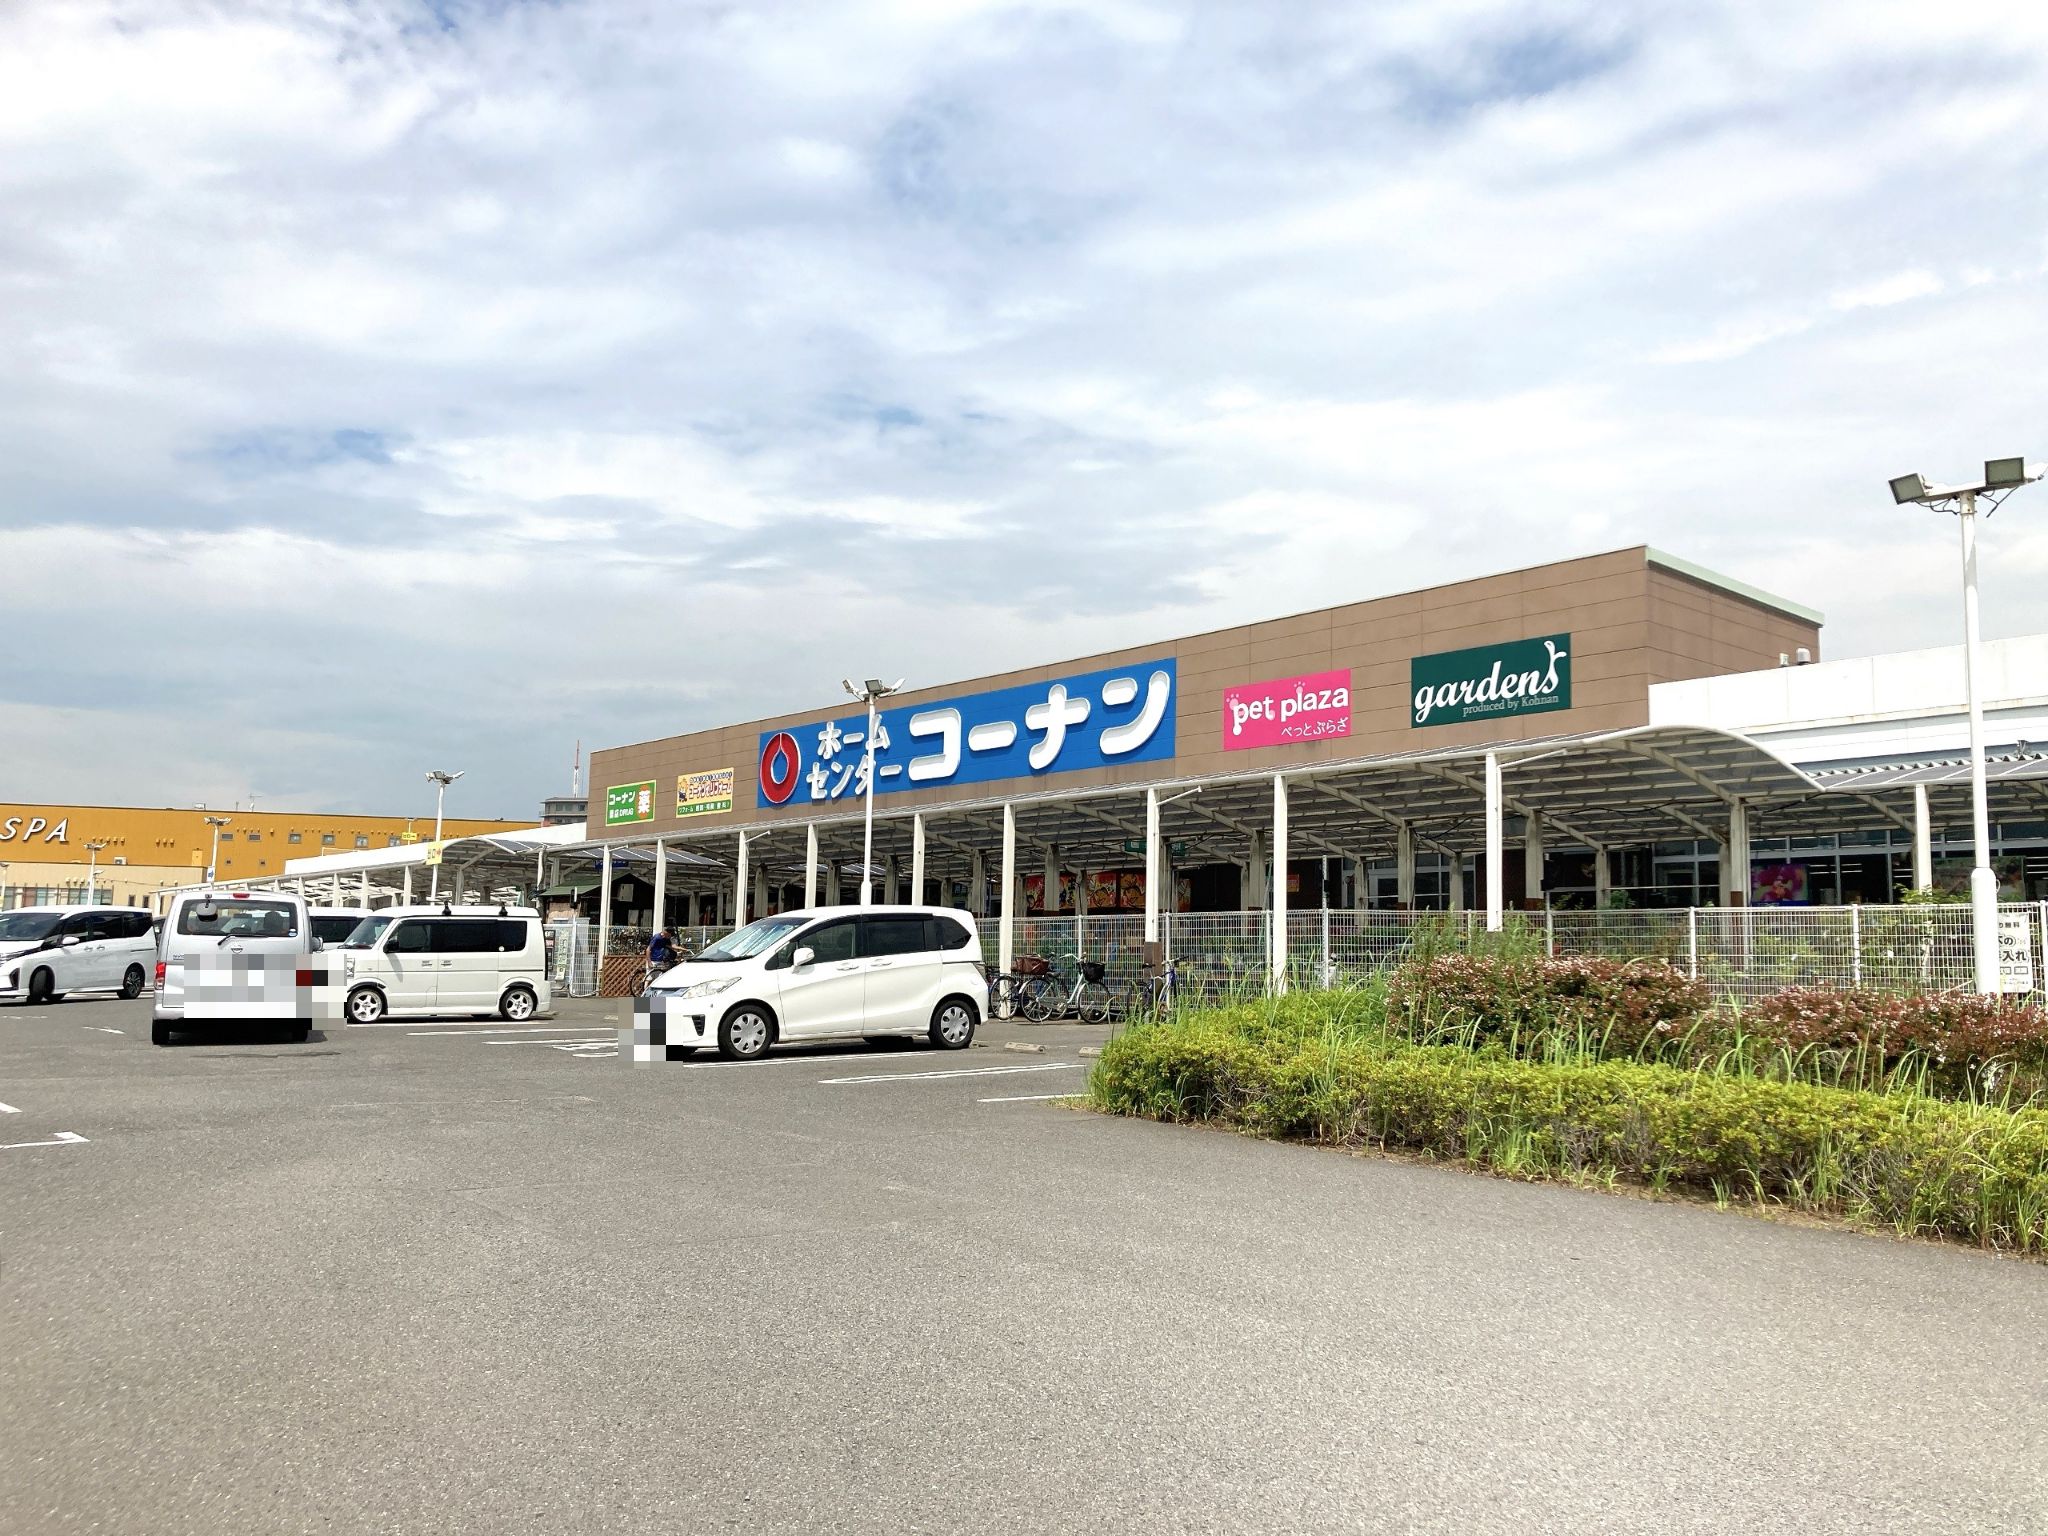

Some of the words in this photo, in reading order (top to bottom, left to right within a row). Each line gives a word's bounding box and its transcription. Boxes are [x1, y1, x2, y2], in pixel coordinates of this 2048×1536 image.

[1414, 640, 1567, 723] gardens
[1228, 696, 1276, 736] pet
[1281, 685, 1349, 723] plaza
[1462, 699, 1505, 717] produced
[1508, 699, 1519, 711] by
[1521, 695, 1559, 708] Kohnan
[818, 713, 891, 760] ホーム
[908, 670, 1170, 781] コーナン
[1281, 717, 1349, 737] ぺっとぷらざ
[608, 791, 636, 806] コーナン
[0, 817, 69, 843] SPA
[1999, 950, 2027, 961] 入れ
